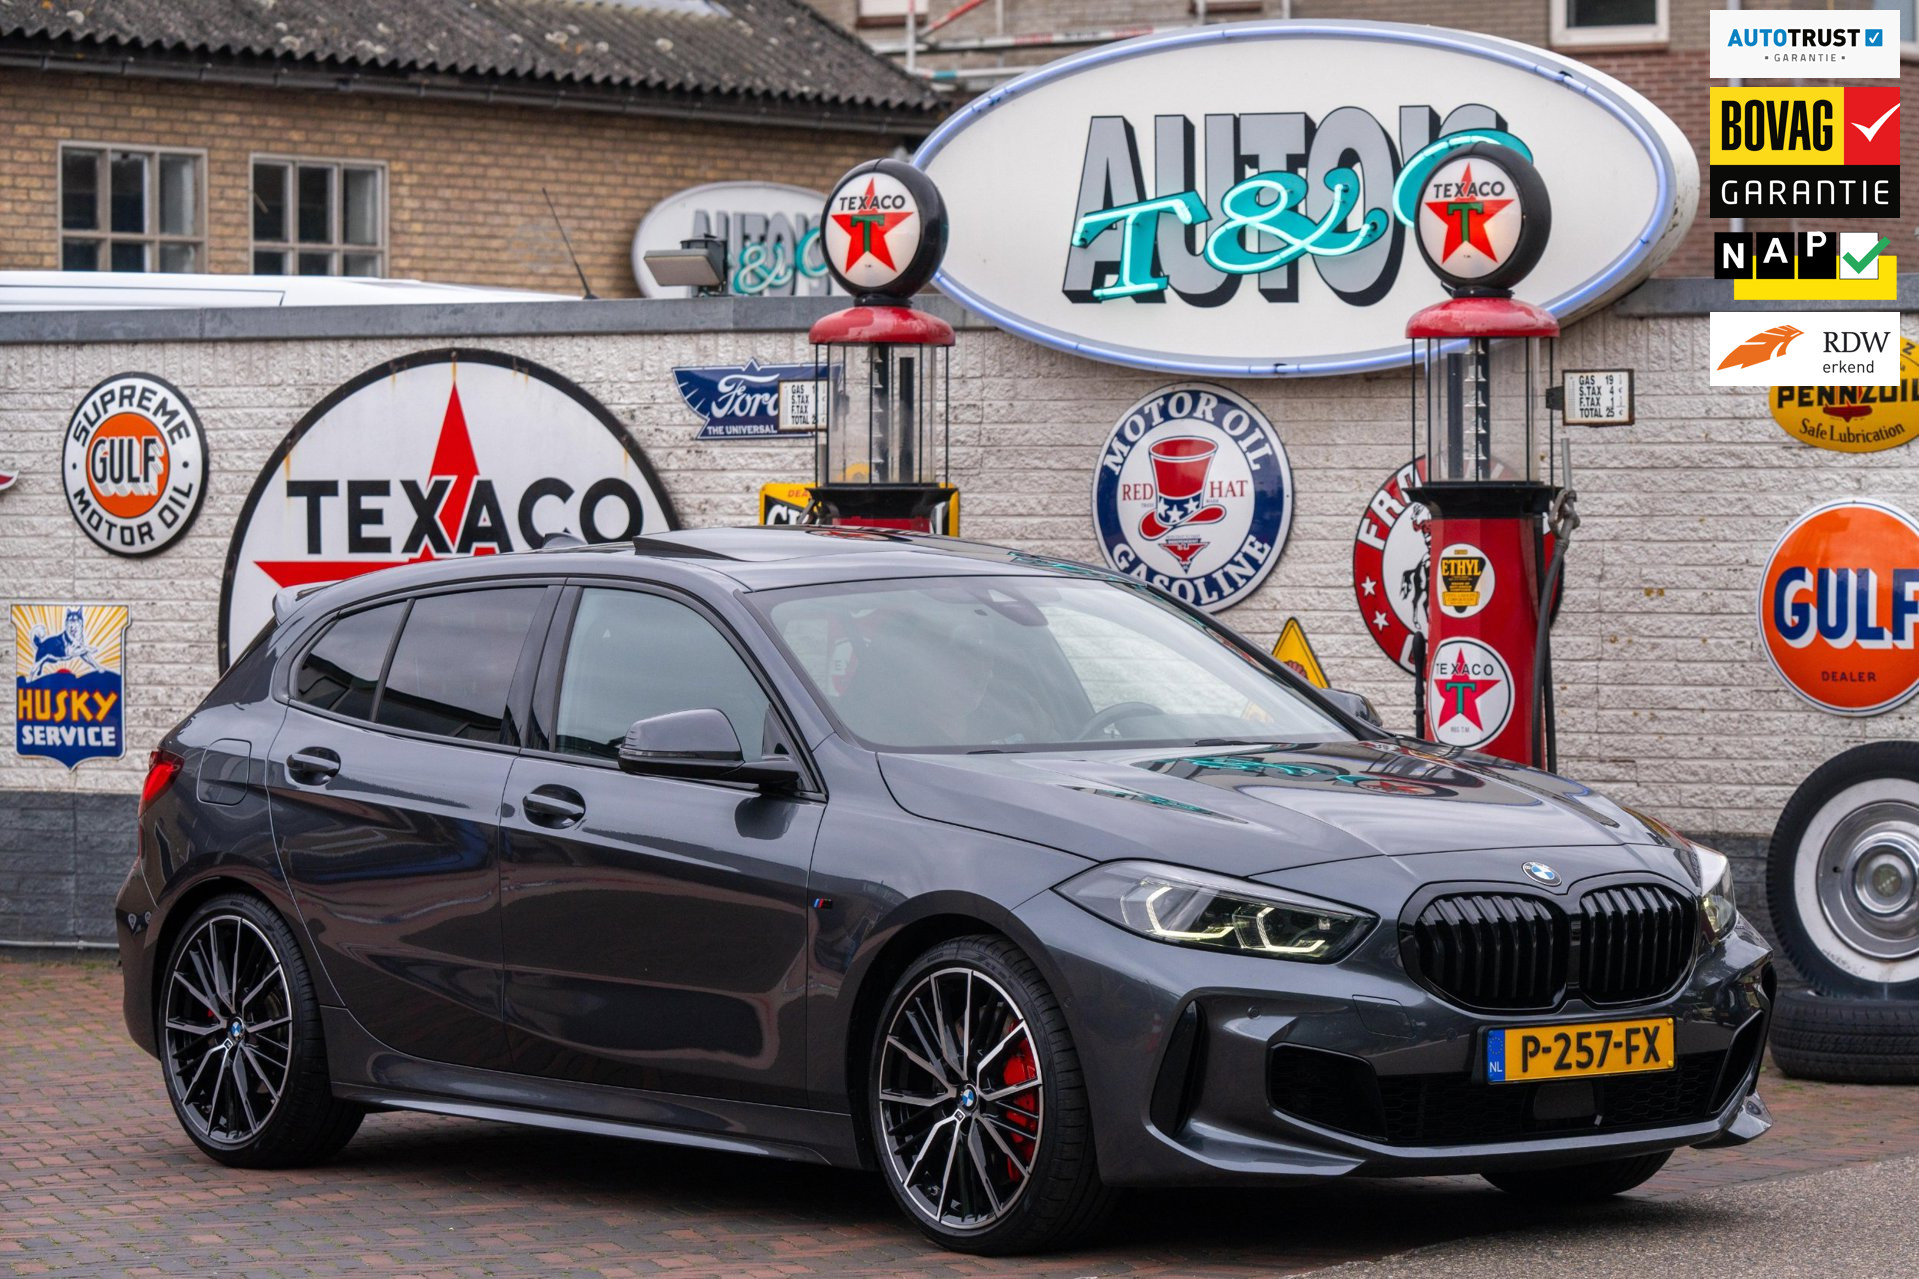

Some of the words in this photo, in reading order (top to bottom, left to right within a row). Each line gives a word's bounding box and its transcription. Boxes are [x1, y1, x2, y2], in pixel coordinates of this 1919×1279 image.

[1433, 181, 1505, 198] TEXACO
[839, 194, 906, 211] TEXACO
[1447, 202, 1484, 242] T
[850, 214, 885, 252] T
[791, 385, 805, 394] GAS
[1579, 375, 1595, 385] GAS
[1605, 374, 1614, 385] 19
[791, 395, 809, 404] S.TAX
[1579, 386, 1602, 396] S.TAX
[1609, 386, 1614, 395] 4
[791, 406, 808, 415] F.TAX
[1579, 397, 1601, 407] F.TAX
[73, 385, 191, 447] SUPREME
[791, 415, 809, 425] TOTAL
[1579, 408, 1603, 418] TOTAL
[1605, 408, 1615, 418] 25
[707, 426, 725, 435] THE
[726, 424, 778, 434] UNIVERSAL
[1103, 391, 1218, 475] MOTOR
[1222, 409, 1273, 471] OIL
[1799, 418, 1828, 440] Safe
[1829, 423, 1905, 444] Lubrication
[91, 436, 158, 485] GULF
[1122, 483, 1154, 501] RED
[1209, 480, 1248, 498] HAT
[74, 487, 154, 546] MOTOR
[163, 482, 193, 528] OIL
[286, 477, 644, 555] TEXACO
[1112, 534, 1272, 604] GASOLINE
[1441, 559, 1481, 576] ETHYL
[1774, 566, 1919, 642] GULF
[1821, 671, 1876, 682] DEALER
[17, 688, 119, 723] HUSKY
[1445, 682, 1476, 714] T
[22, 725, 116, 747] SERVICE
[1521, 1025, 1661, 1074] P-257-FX
[1489, 1061, 1503, 1073] NL
